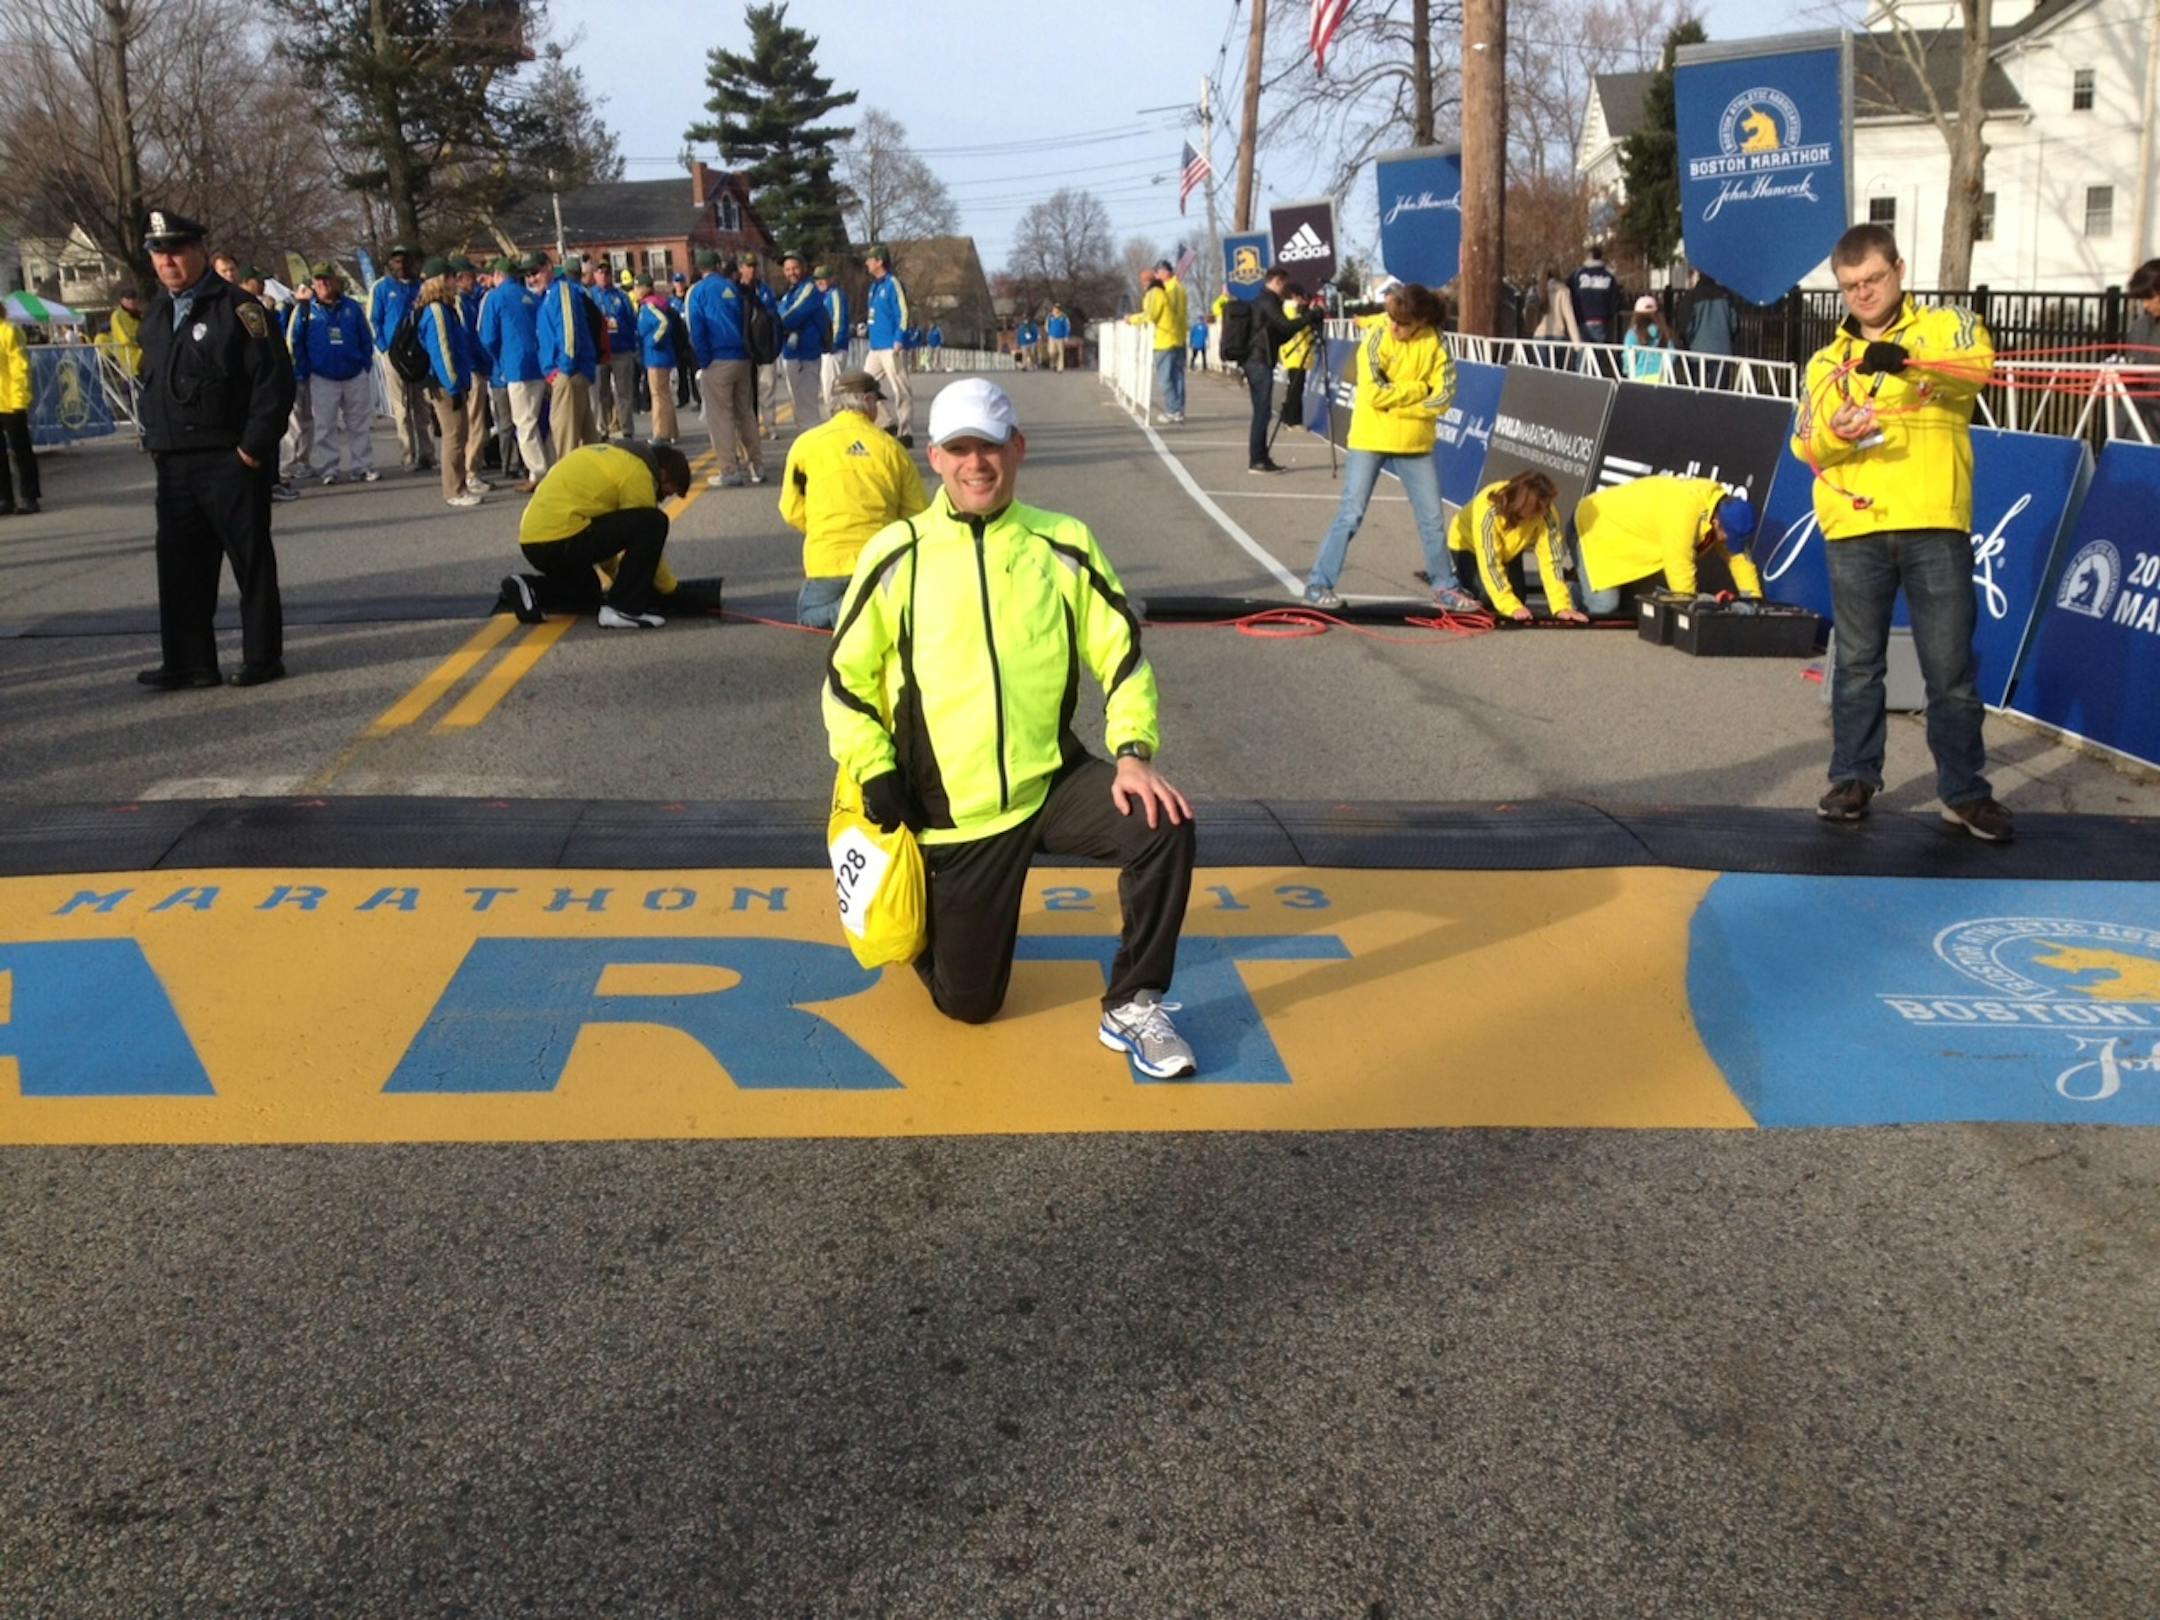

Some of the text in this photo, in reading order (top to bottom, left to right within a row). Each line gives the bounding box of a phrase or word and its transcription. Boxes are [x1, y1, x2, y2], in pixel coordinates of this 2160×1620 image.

[1690, 148, 1830, 177] BOSTON MARATHON
[1702, 171, 1819, 222] John Hancock
[1278, 244, 1331, 262] adidas
[2112, 589, 2160, 635] MA
[51, 885, 1332, 915] MARATHON 213
[1883, 999, 2151, 1024] BOSTON
[2056, 1034, 2160, 1101] Jo
